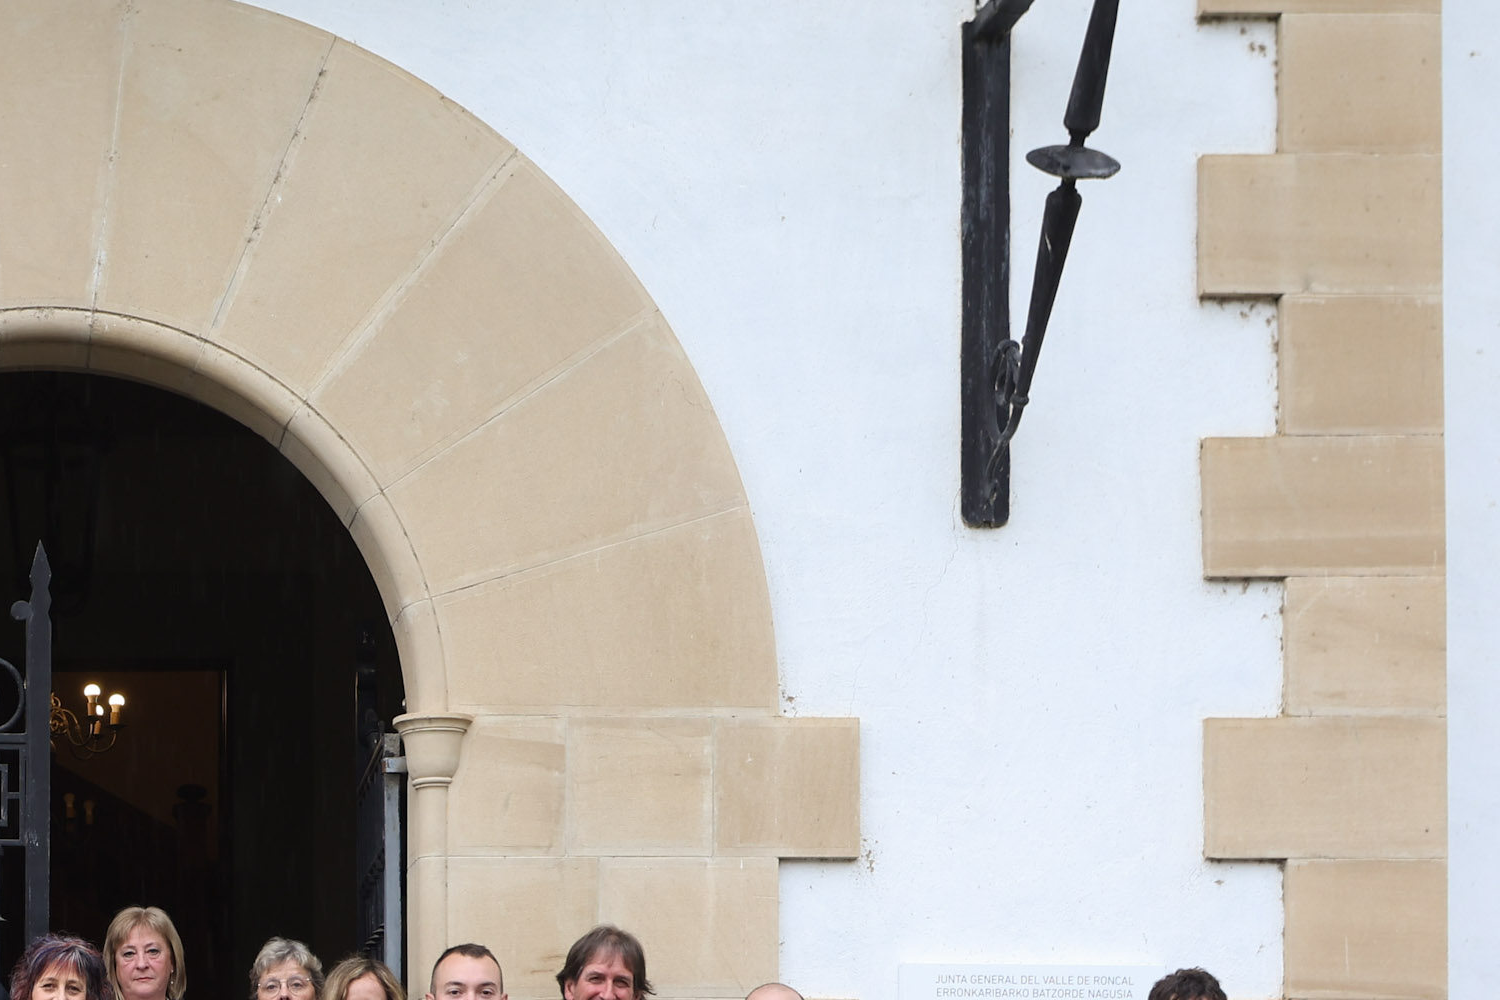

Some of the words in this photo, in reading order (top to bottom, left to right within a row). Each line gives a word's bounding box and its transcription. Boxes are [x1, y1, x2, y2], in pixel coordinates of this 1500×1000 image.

[935, 974, 967, 985] JUNTA
[970, 974, 1017, 985] GENERAL
[1020, 975, 1040, 985] DEL
[1043, 975, 1074, 986] VALLE
[1077, 975, 1090, 986] DE
[1094, 975, 1134, 986] RONCAL
[936, 987, 1030, 998] ERRONKARIBARKO
[1032, 988, 1085, 999] BATZORDE
[1088, 988, 1133, 999] NAGUSIA
